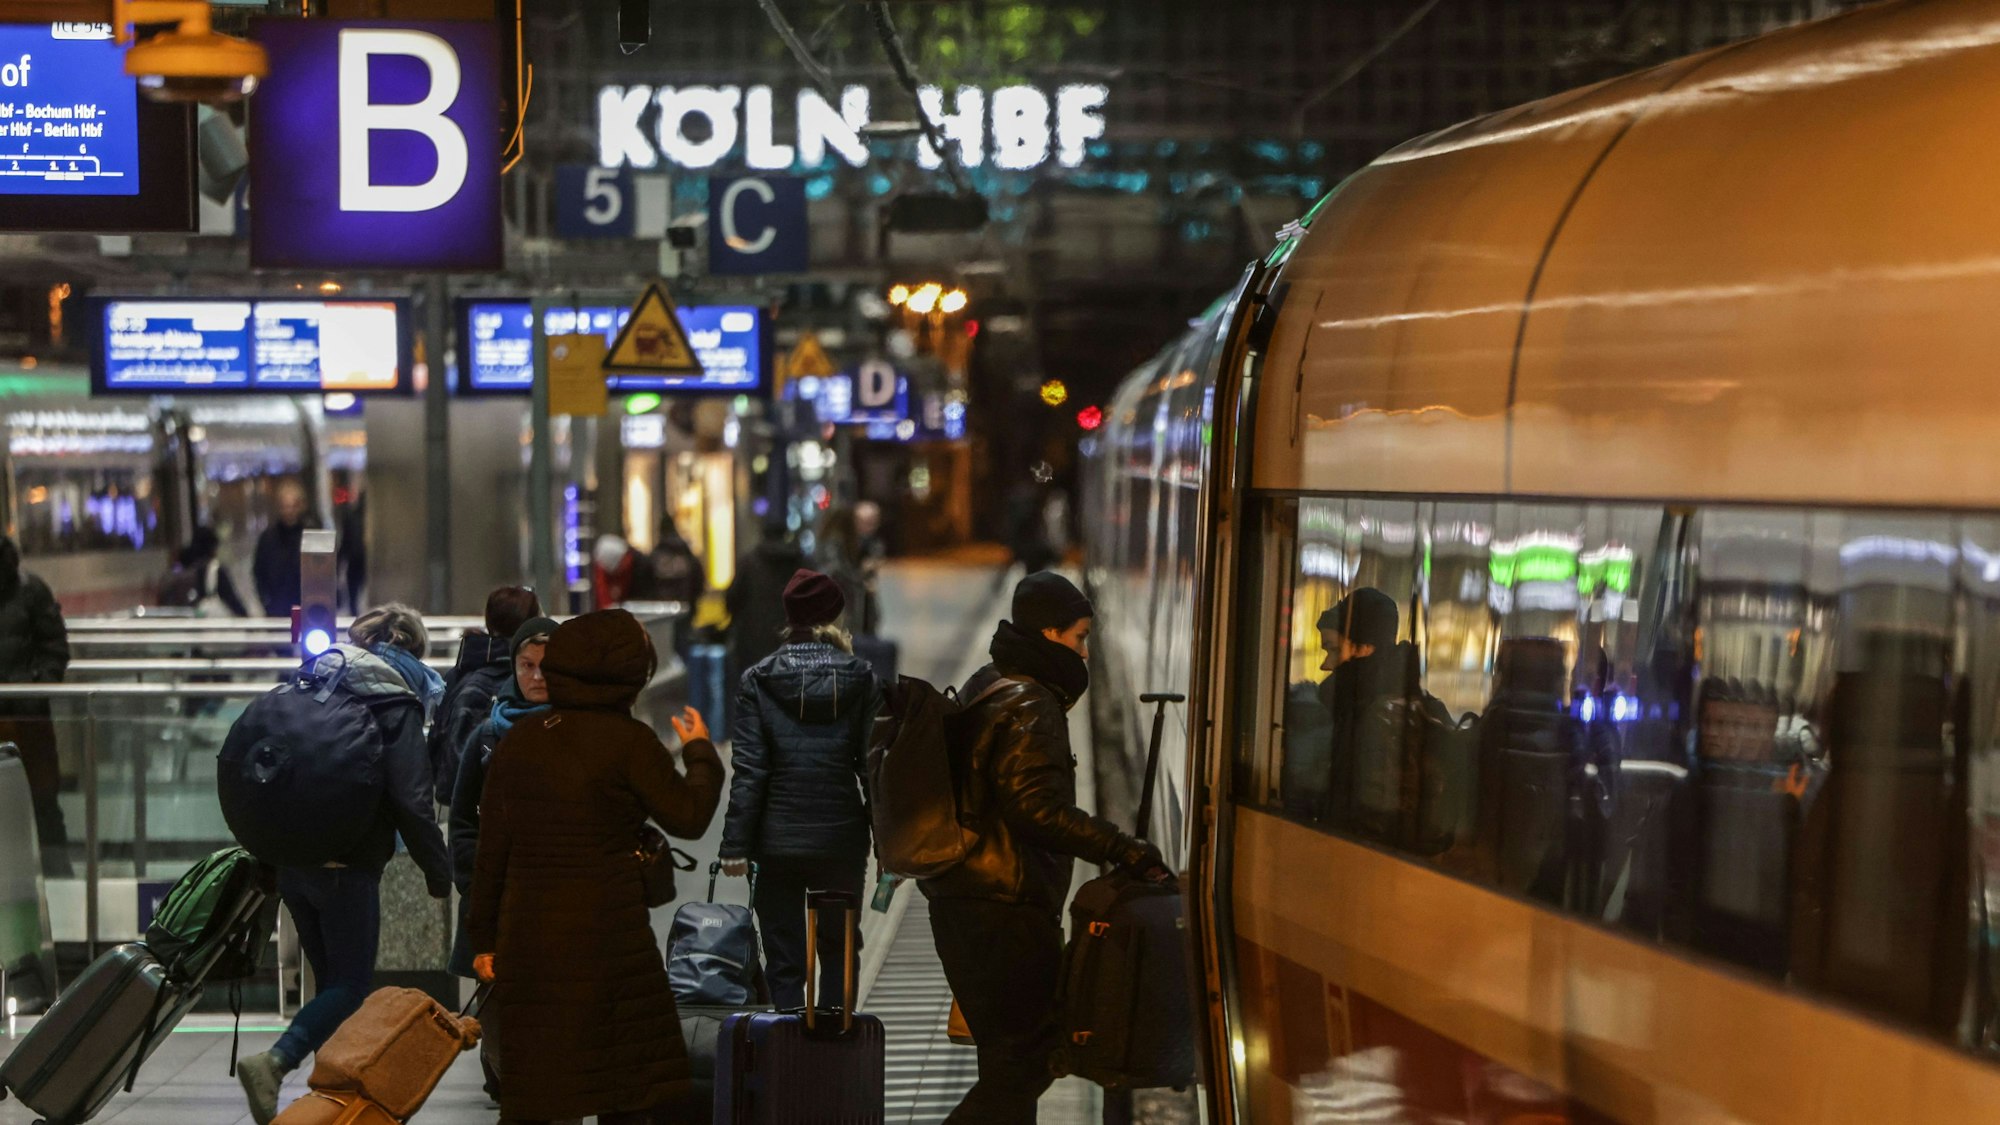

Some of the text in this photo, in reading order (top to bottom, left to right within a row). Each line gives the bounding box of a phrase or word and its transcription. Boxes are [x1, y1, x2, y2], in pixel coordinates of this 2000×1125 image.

[0, 103, 14, 118] bf
[25, 103, 73, 118] Bochum
[74, 104, 96, 118] Hbf
[10, 121, 32, 136] Hbf
[44, 122, 79, 137] Berlin
[81, 122, 103, 137] Hbf
[338, 28, 469, 212] B
[599, 83, 1110, 170] KÖLN HBF
[23, 143, 87, 154] F G
[583, 166, 622, 225] 5
[720, 178, 776, 254] C
[859, 359, 896, 406] D
